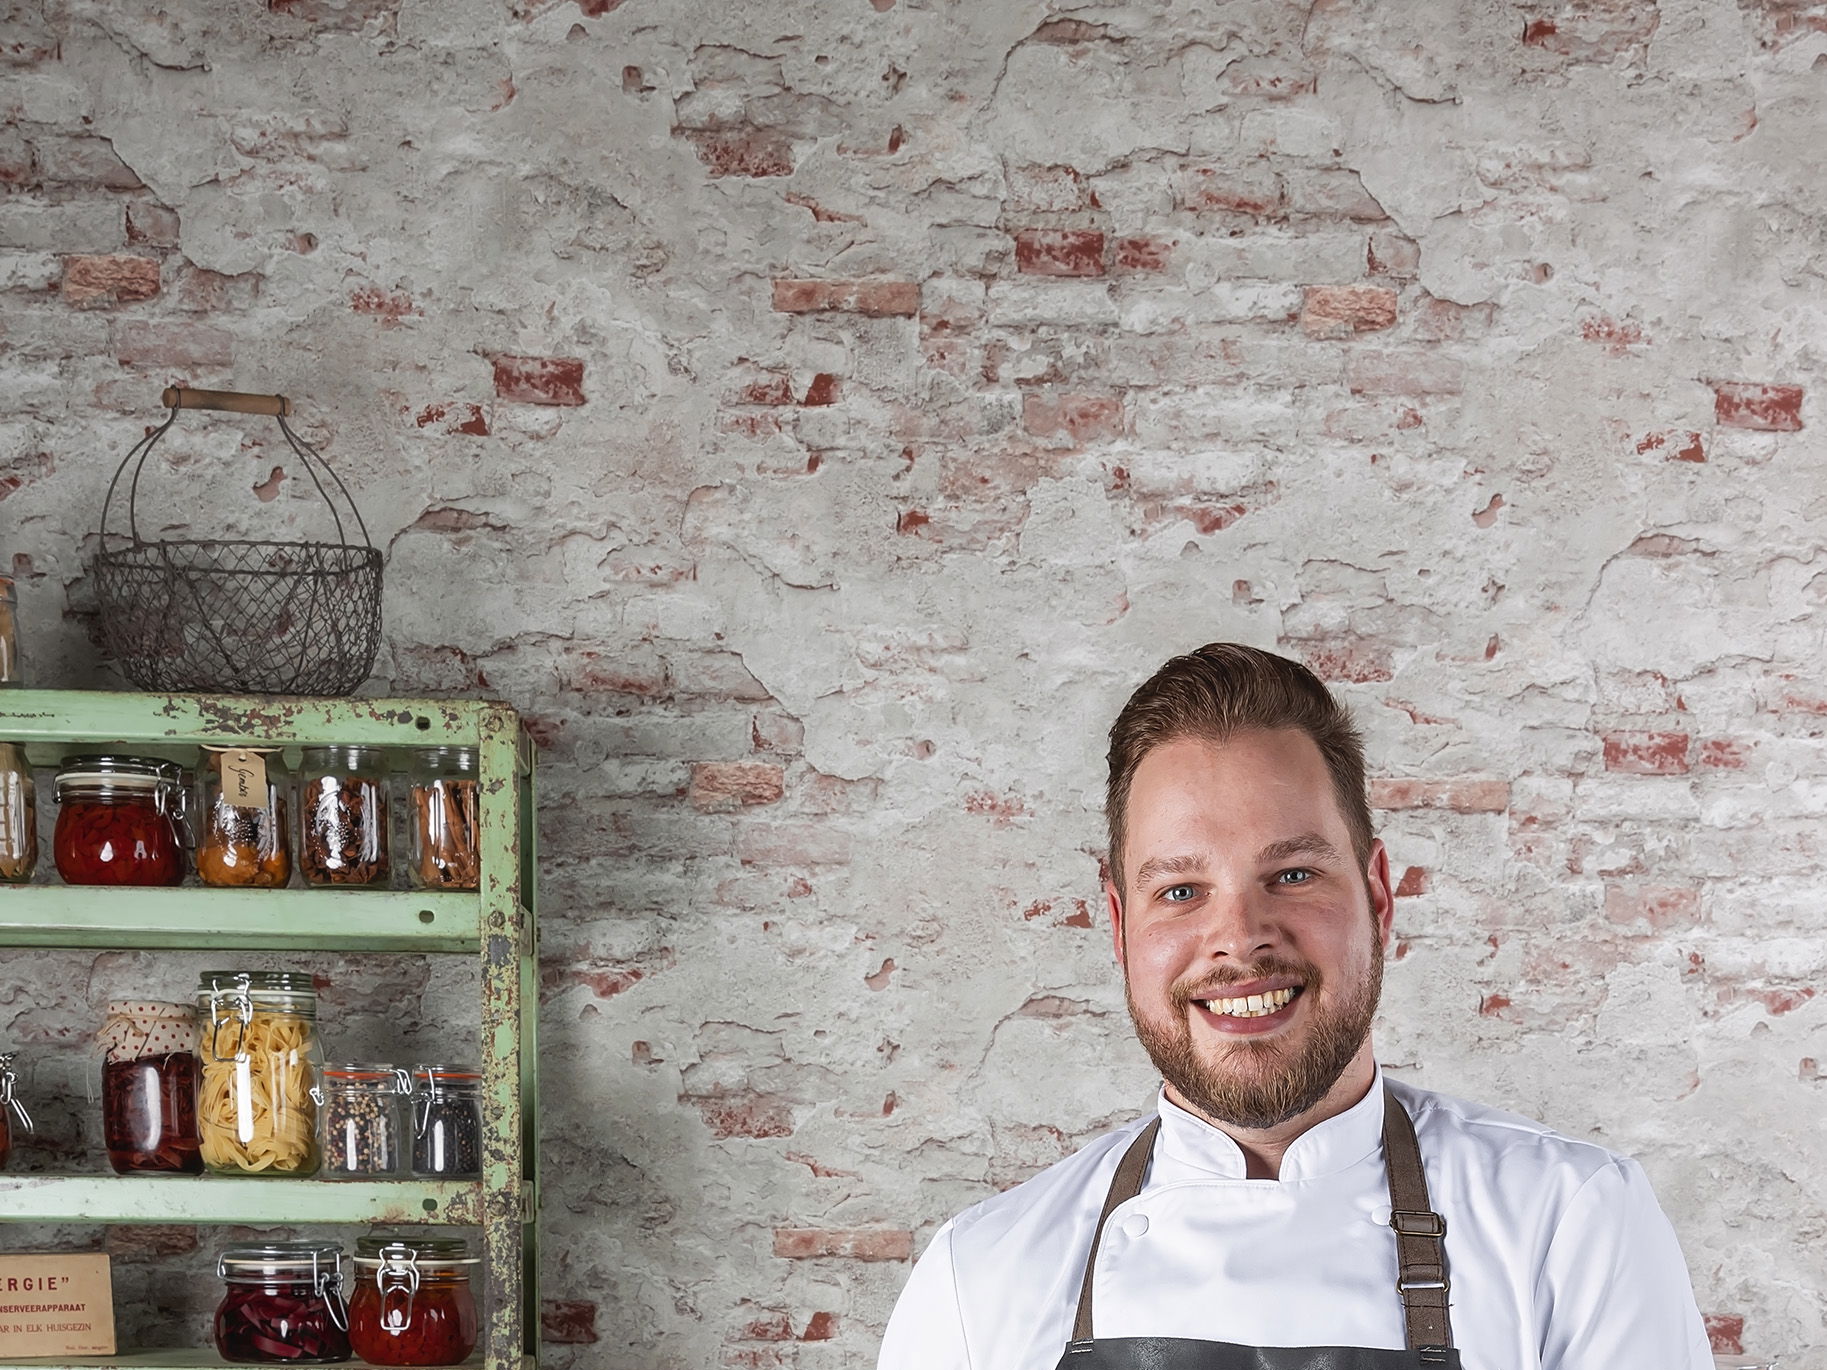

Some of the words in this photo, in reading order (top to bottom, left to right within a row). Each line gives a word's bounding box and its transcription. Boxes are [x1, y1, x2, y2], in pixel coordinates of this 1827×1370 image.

[0, 1277, 69, 1291] RGIE”
[13, 1324, 23, 1333] IN
[26, 1323, 43, 1333] ELK
[46, 1322, 92, 1332] HUISGEZIN
